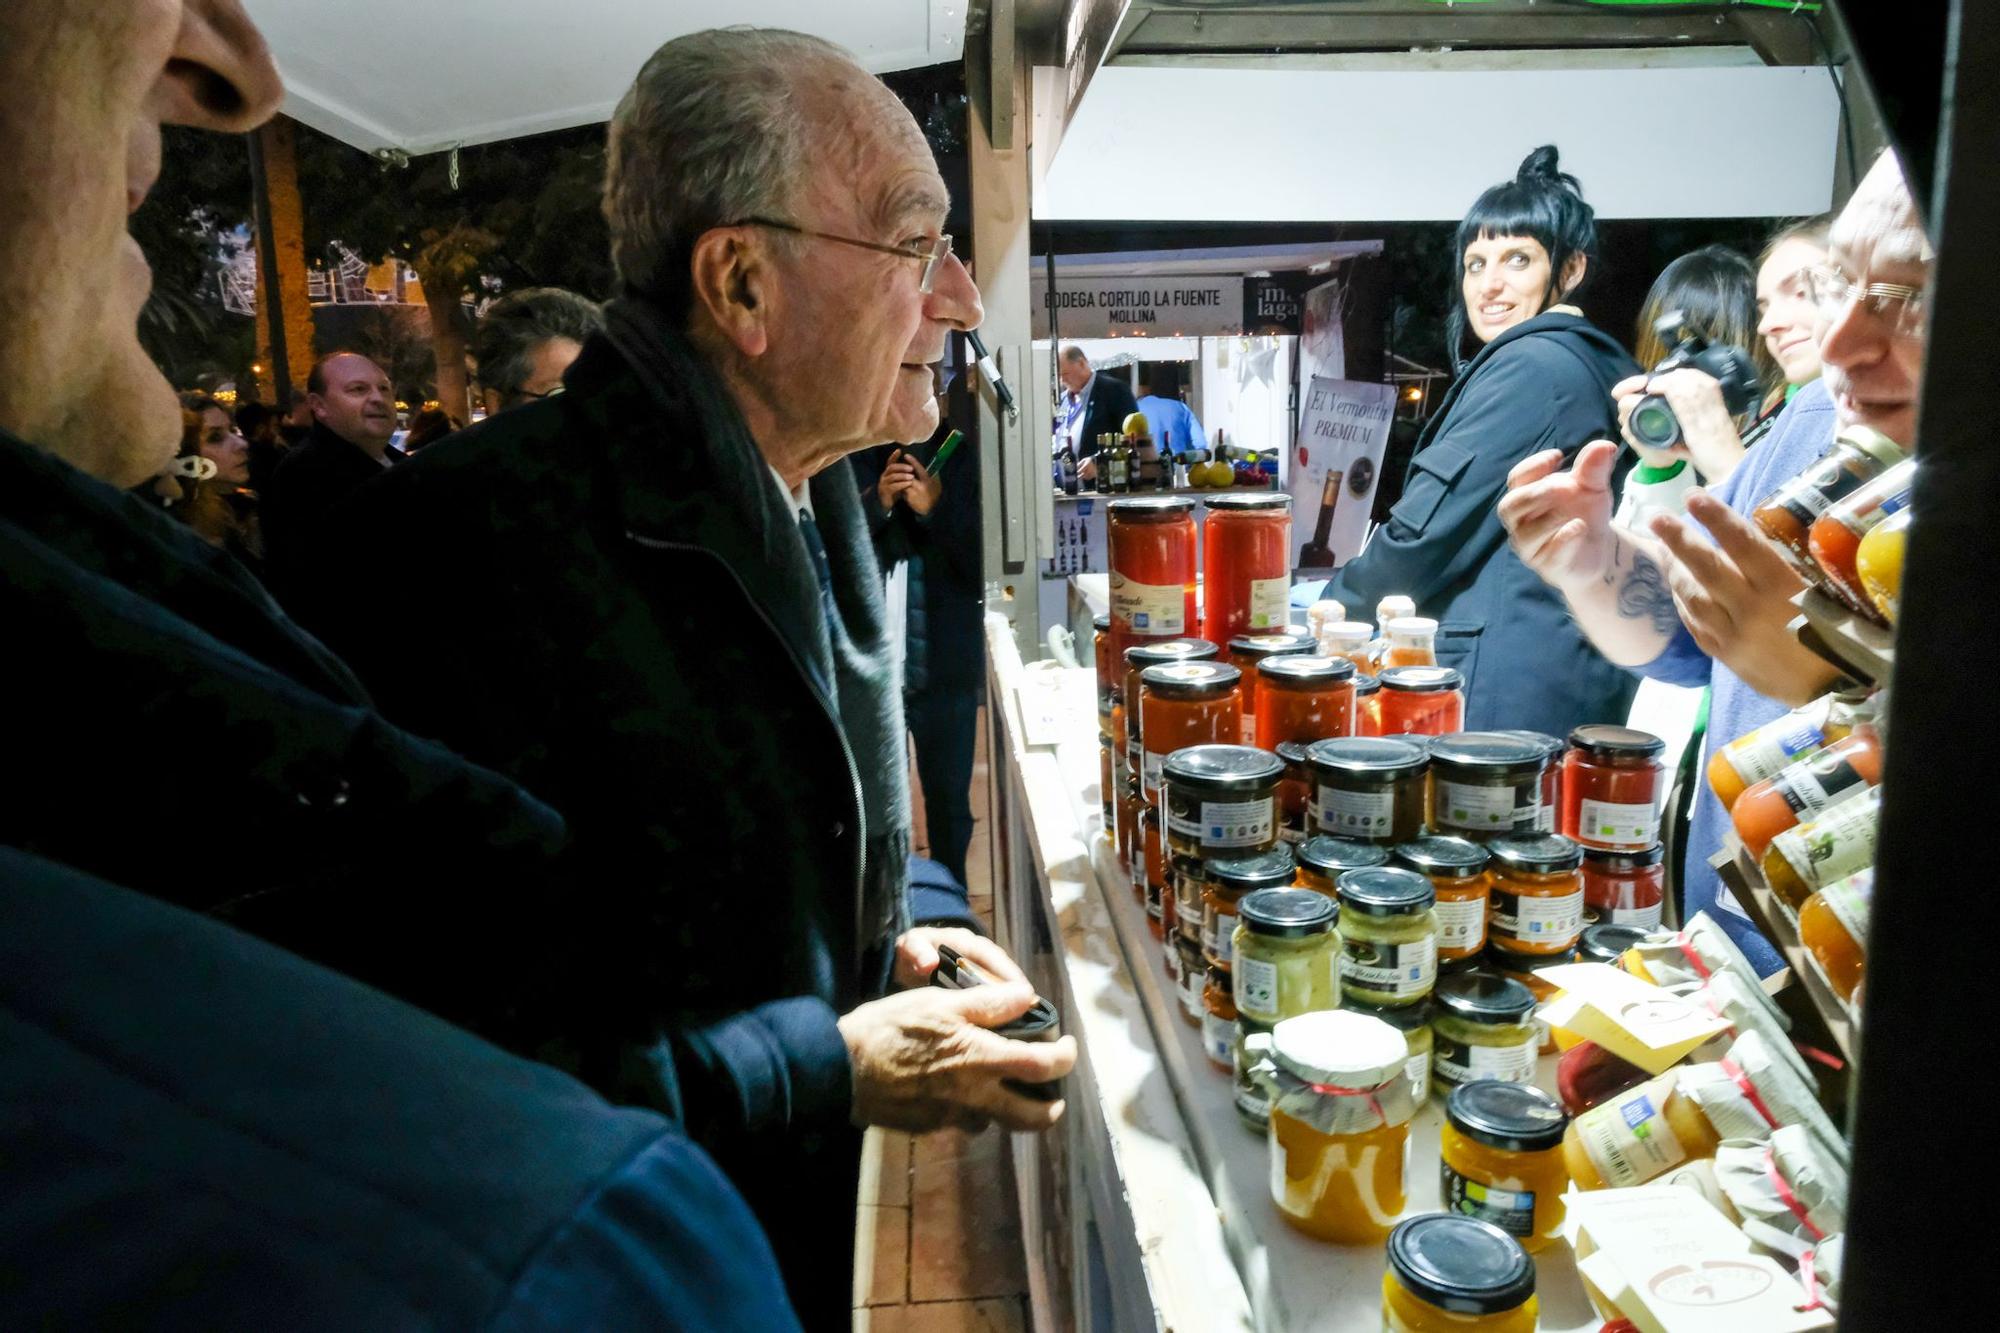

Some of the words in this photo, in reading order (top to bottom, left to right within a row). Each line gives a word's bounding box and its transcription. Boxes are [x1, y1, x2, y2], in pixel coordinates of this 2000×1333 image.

[1044, 292, 1095, 308] BODEGA
[1099, 290, 1150, 307] CORTIJO
[1154, 290, 1170, 306] LA
[1173, 289, 1221, 306] FUENTE
[1108, 309, 1156, 324] MOLLINA
[1310, 390, 1327, 411] El
[1328, 392, 1388, 421] Vermouth
[1313, 419, 1374, 444] PREMIUM
